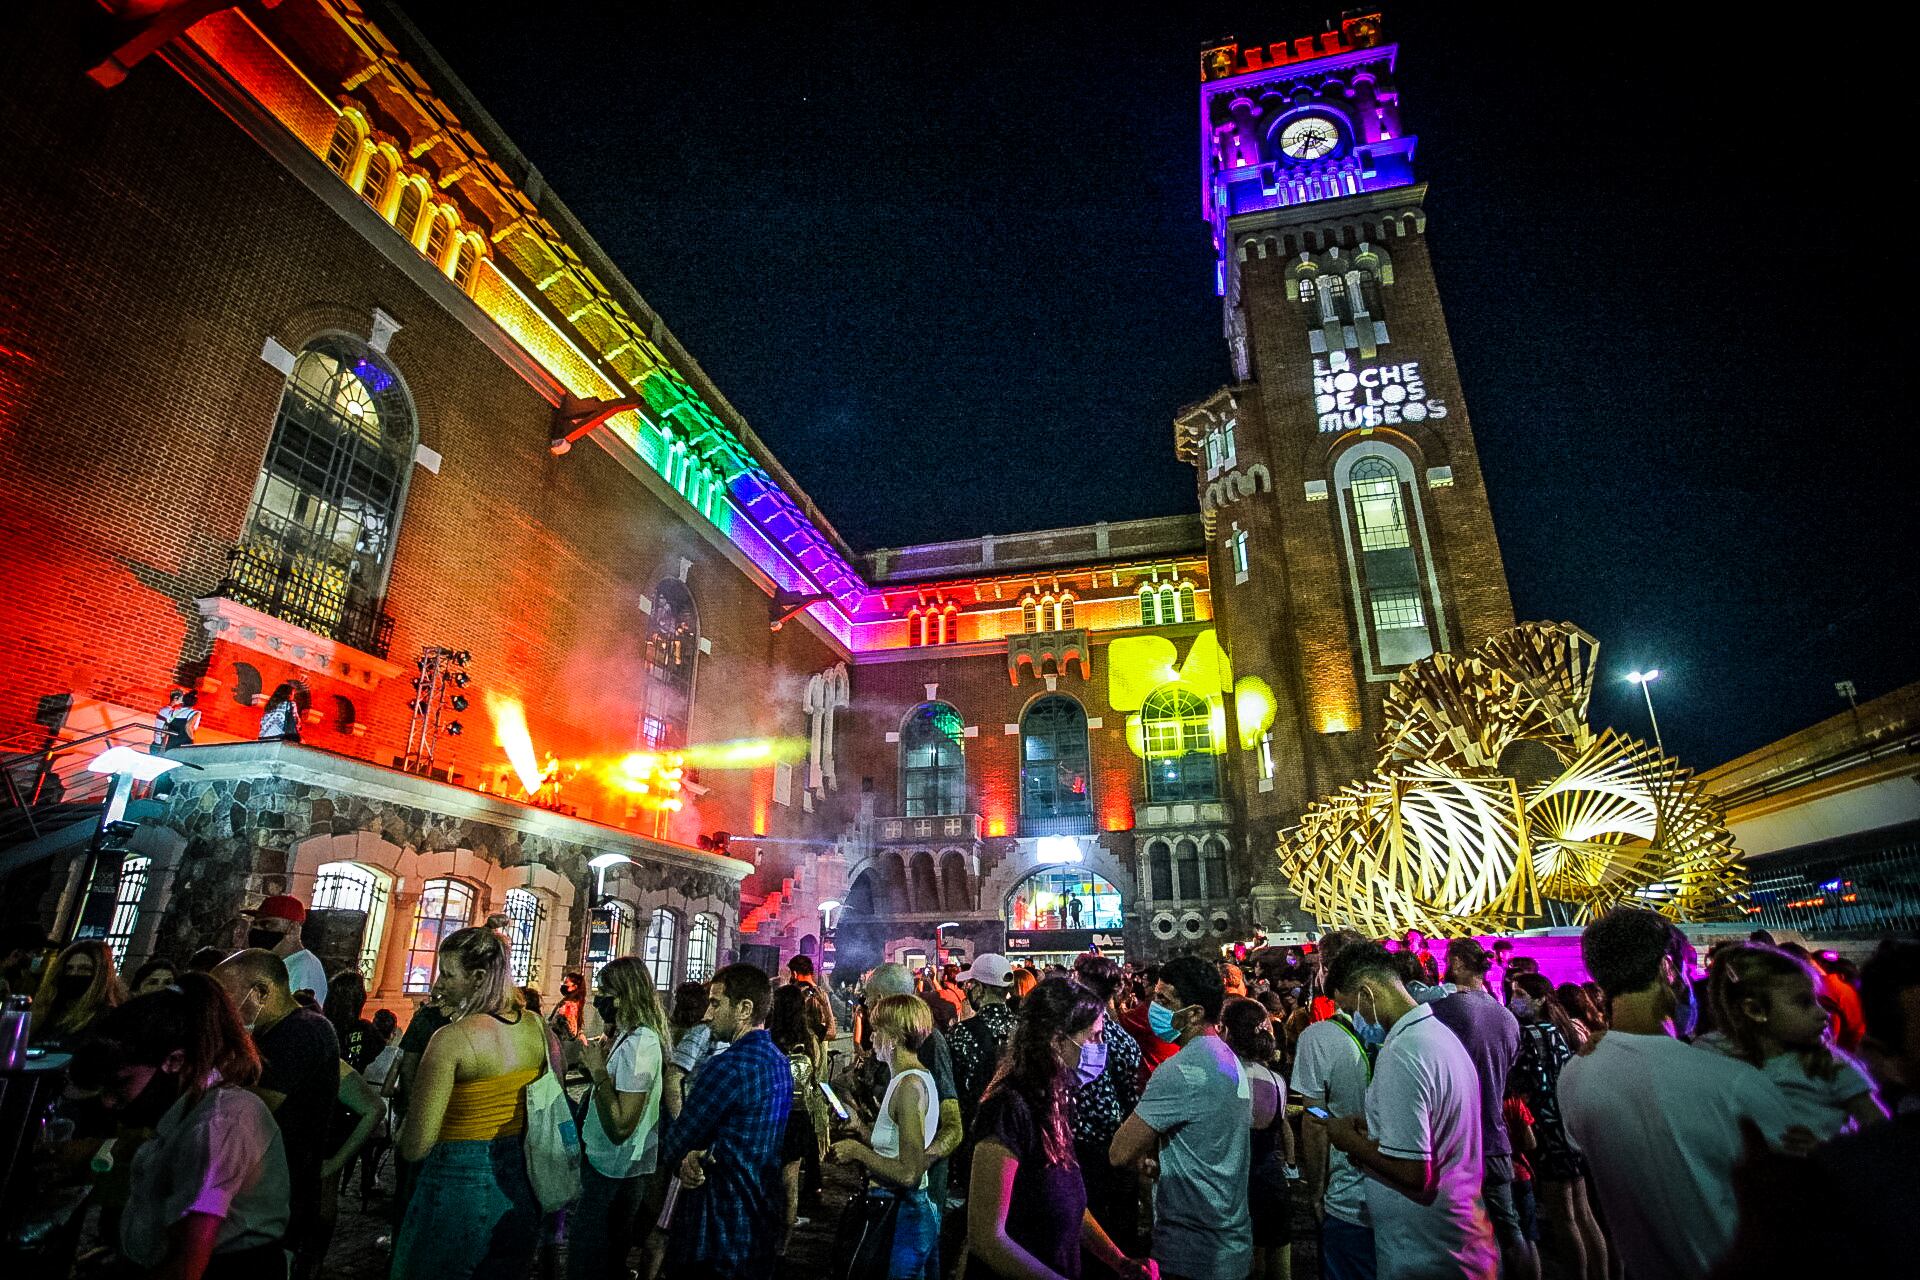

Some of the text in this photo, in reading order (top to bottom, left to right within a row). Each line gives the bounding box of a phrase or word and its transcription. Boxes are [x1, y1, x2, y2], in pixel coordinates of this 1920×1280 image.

[1313, 351, 1350, 376] LA
[1314, 362, 1419, 395] NOCHE
[1315, 380, 1426, 414] DE LOS
